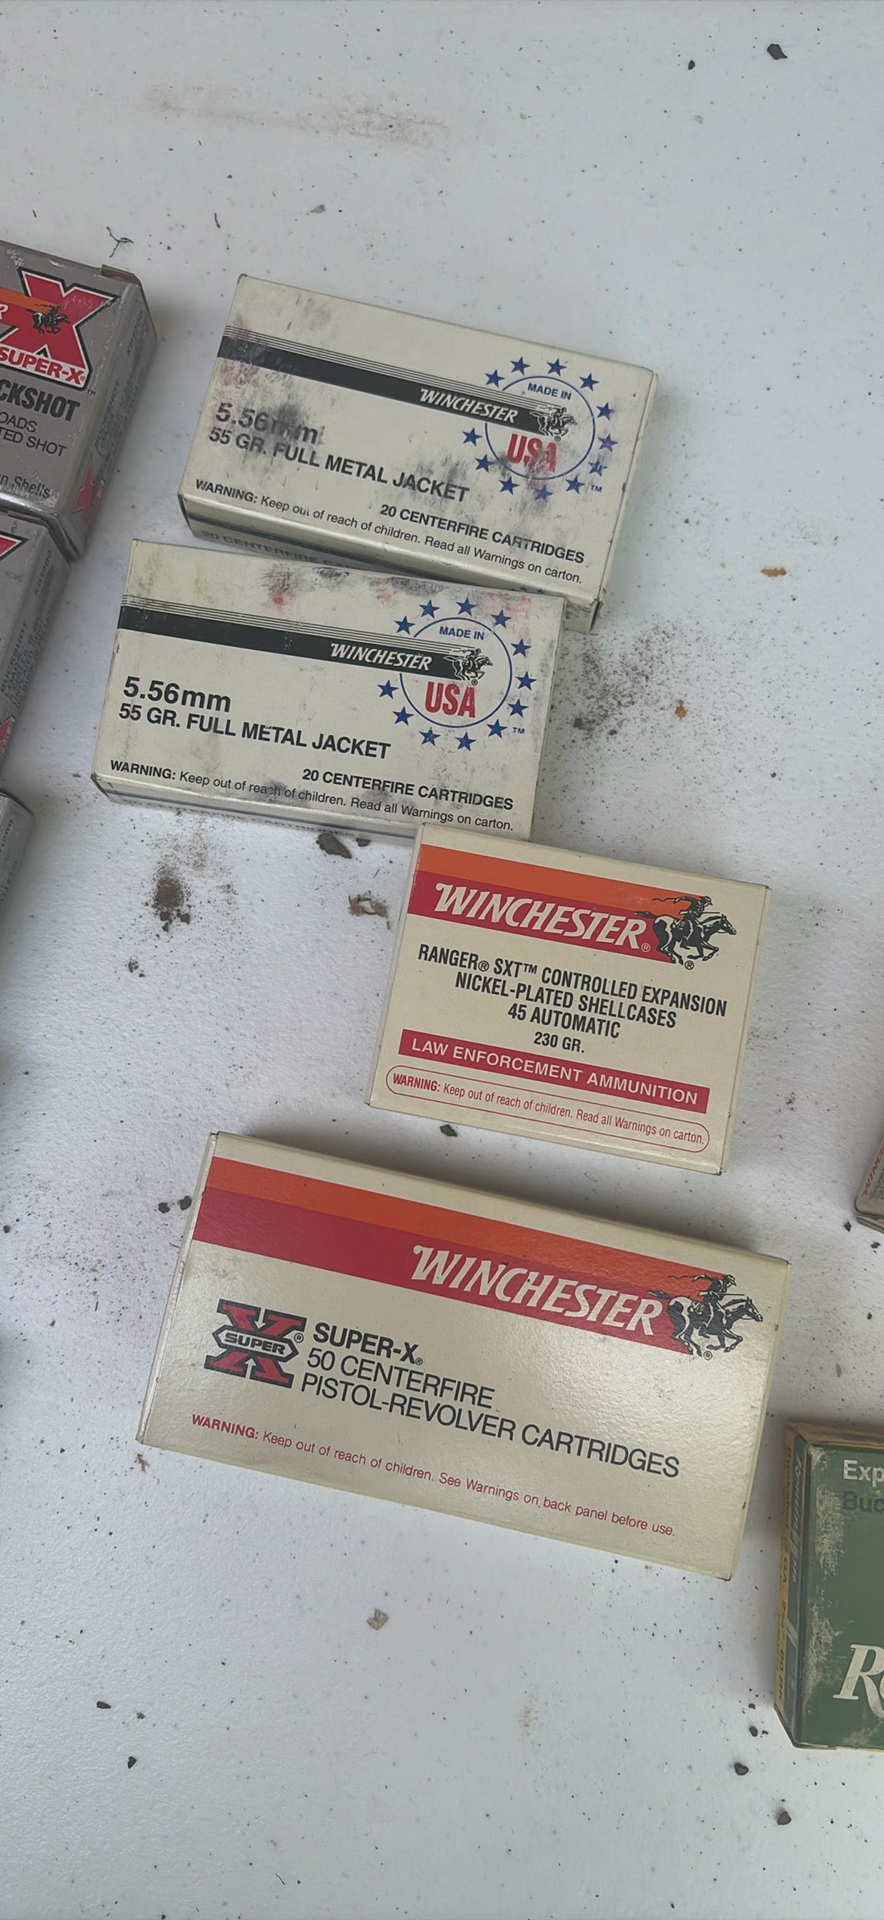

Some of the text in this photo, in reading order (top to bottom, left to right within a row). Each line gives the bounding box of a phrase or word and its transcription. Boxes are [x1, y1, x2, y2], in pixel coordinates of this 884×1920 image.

[419, 388, 519, 424] WINCHESTER
[528, 382, 572, 400] MADE IN
[26, 435, 67, 457] SHOT
[209, 427, 471, 502] 55 GR. FULL METAL JACKET
[507, 433, 558, 473] USA
[195, 479, 583, 584] WARNING: Keep out of reach of children. Read all Warnings on carton.
[201, 530, 220, 541] 20
[380, 504, 586, 564] 20 CENTERFIRE CARTRIDGES
[0, 621, 28, 693] BUCKSHOT
[330, 642, 433, 671] WINCHESTER
[439, 626, 485, 641] MADE IN
[123, 676, 232, 713] 5.56mm
[424, 681, 477, 719] USA
[119, 702, 392, 760] 55 GR. FULL METAL JACKET
[110, 759, 514, 832] WARNING: Keep out of reach of children. Read all Warnings on carton.
[302, 768, 515, 811] 20 CENTERFIRE CARTRIDGES
[455, 971, 677, 1029] NICKEL-PLATED SHELLCASES
[541, 966, 638, 1000] CONTROLLED
[642, 985, 728, 1017] EXPANSION
[508, 1003, 622, 1039] 45 AUTOMATIC
[533, 1031, 585, 1053] 230 GR.
[411, 1038, 698, 1105] LAW ENFORCEMENT AMMUNITION
[393, 1072, 705, 1145] WARNING: Keep out of reach of children. Read all Warnings on carton.
[411, 1245, 663, 1336] WINCHESTER
[224, 1331, 286, 1356] SUPER
[306, 1347, 495, 1409] 50 CENTERFIRE
[301, 1372, 680, 1478] PISTOL-REVOLVER CARTRIDGES
[192, 1414, 676, 1537] WARNING: Keep out of reach of children. See Warnings on back panel before use.
[832, 1644, 884, 1719] R
